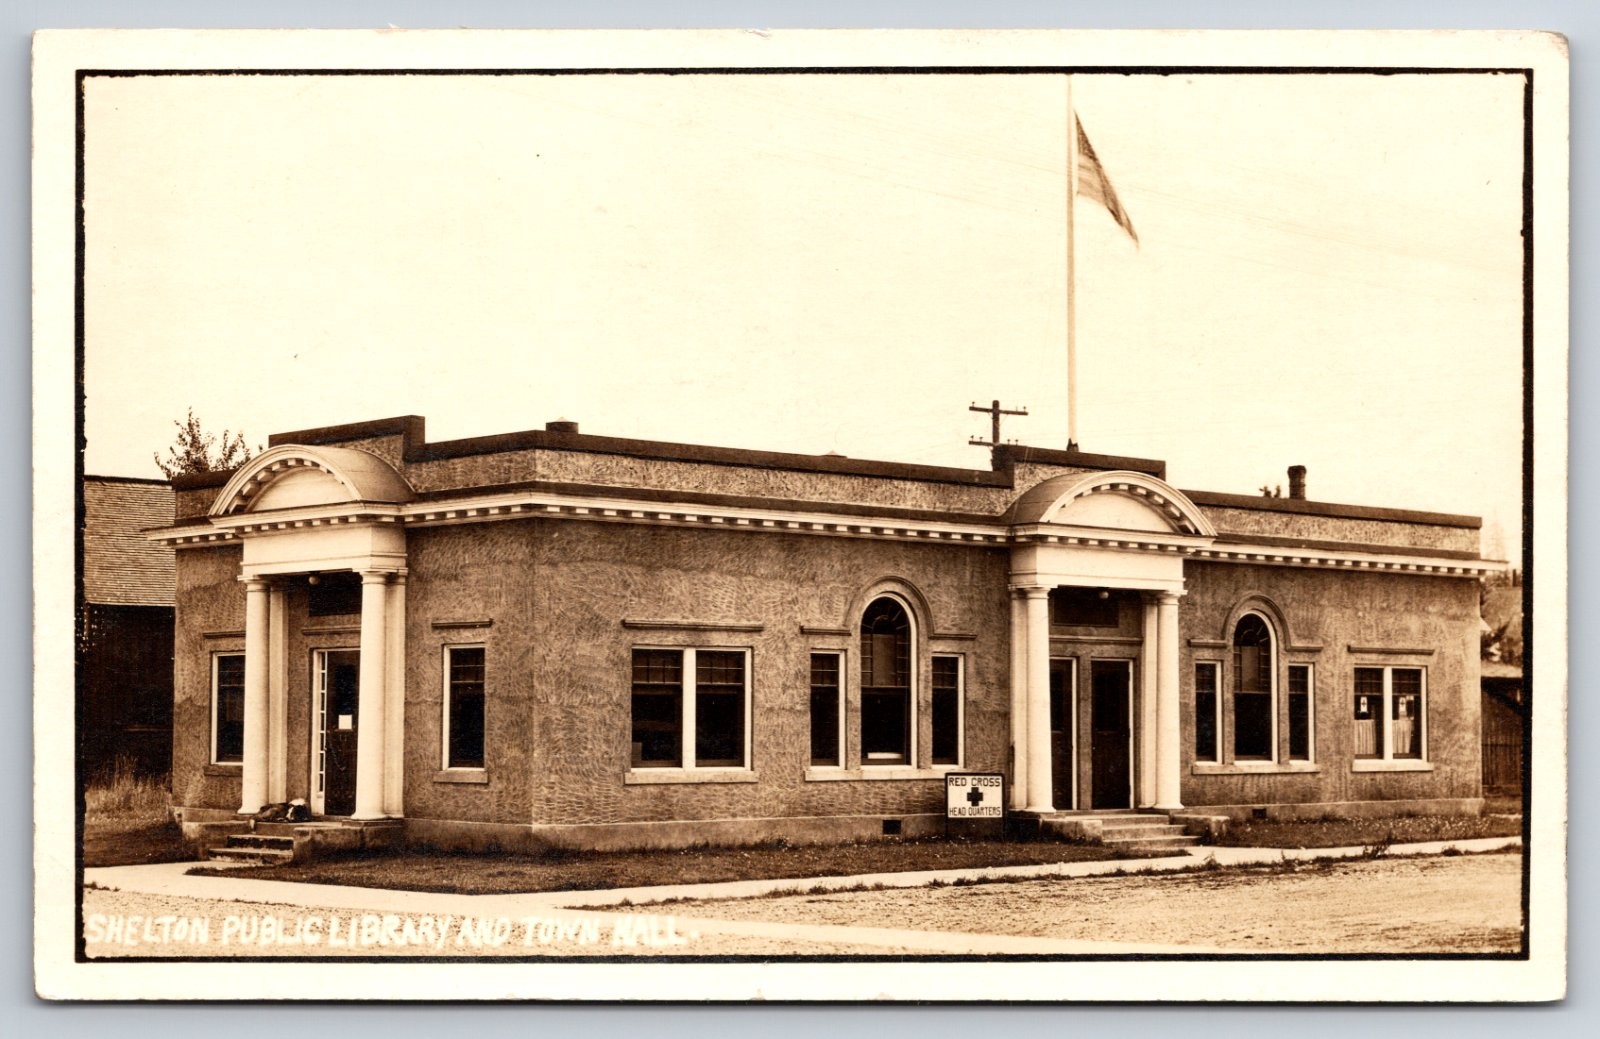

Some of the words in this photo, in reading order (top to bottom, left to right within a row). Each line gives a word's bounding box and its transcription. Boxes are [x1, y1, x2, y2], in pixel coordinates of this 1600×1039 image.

[948, 777, 967, 787] RED
[971, 777, 1001, 787] CROSS
[949, 806, 966, 816] HEAD
[968, 806, 1001, 816] QUARTERS
